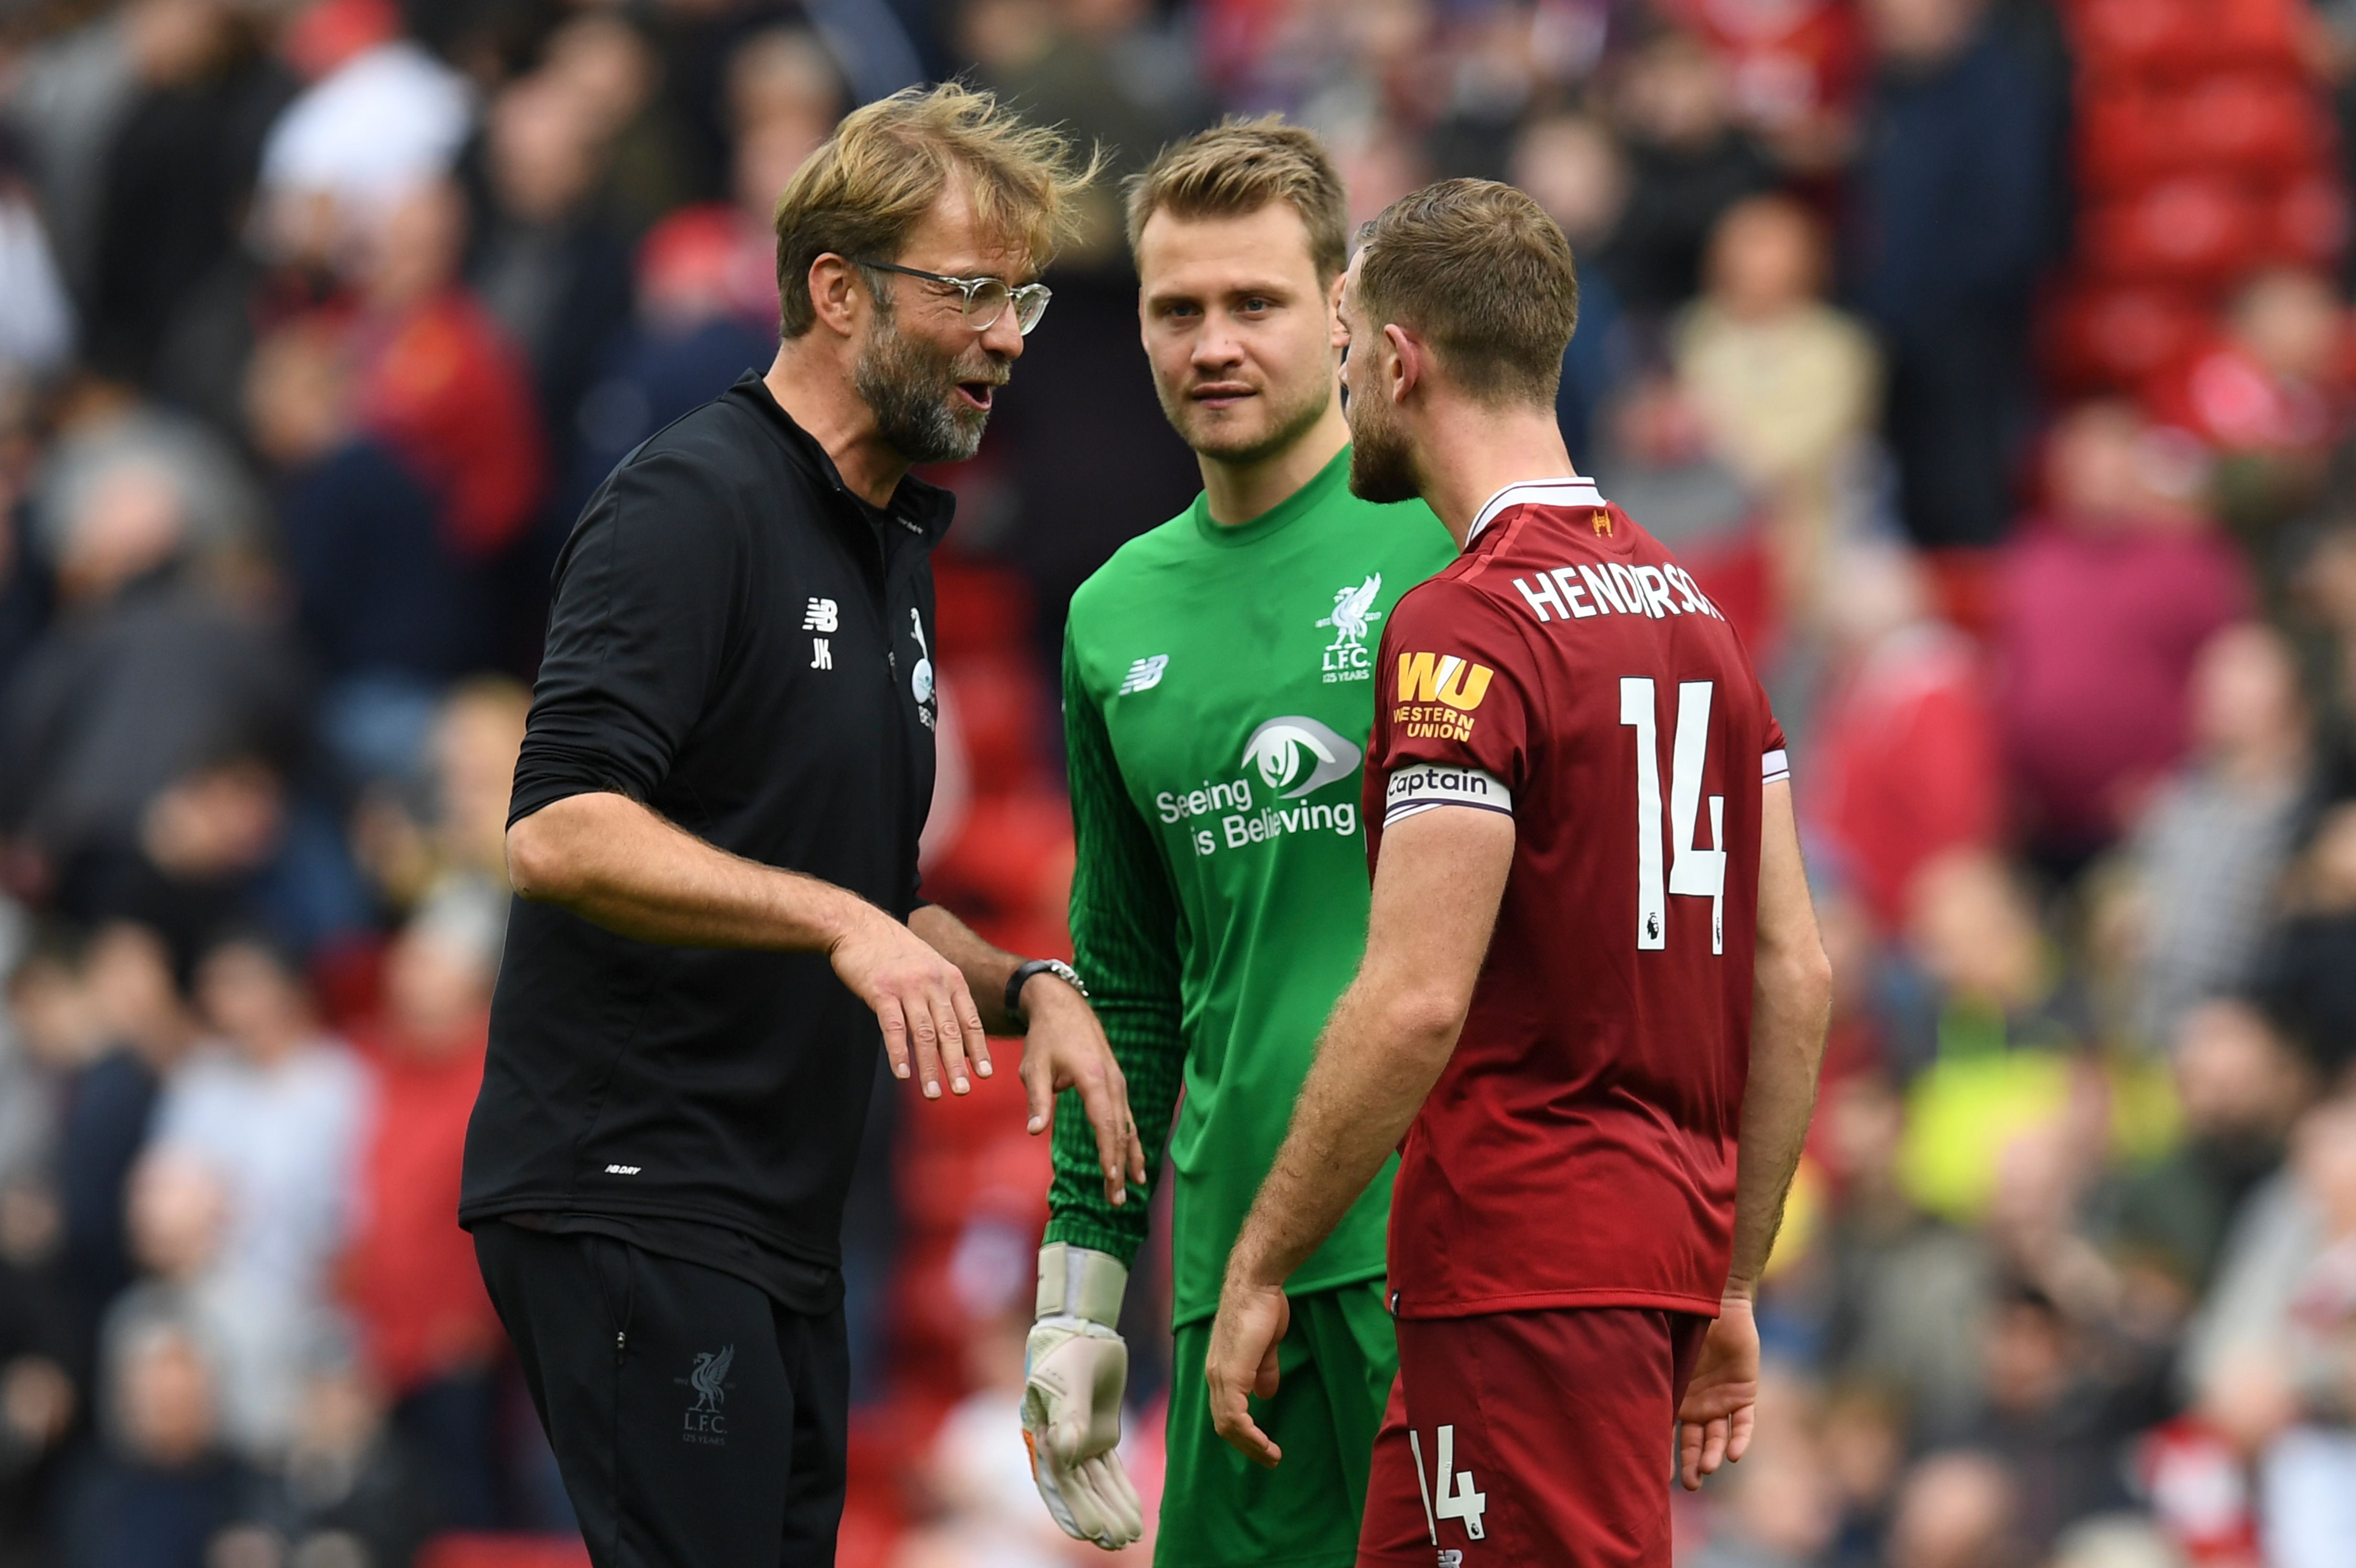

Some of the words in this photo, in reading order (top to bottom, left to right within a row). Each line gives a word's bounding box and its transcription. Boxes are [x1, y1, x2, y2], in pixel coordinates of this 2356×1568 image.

[810, 637, 833, 670] JK
[1338, 669, 1370, 682] YEARS
[1398, 652, 1494, 711] WU
[1393, 706, 1475, 730] WESTERN
[1407, 723, 1471, 742] UNION
[1156, 778, 1253, 824] Seeing
[1619, 677, 1727, 956] 14
[1190, 826, 1216, 857] is
[1222, 799, 1357, 849] Believing
[618, 1165, 642, 1176] DRY
